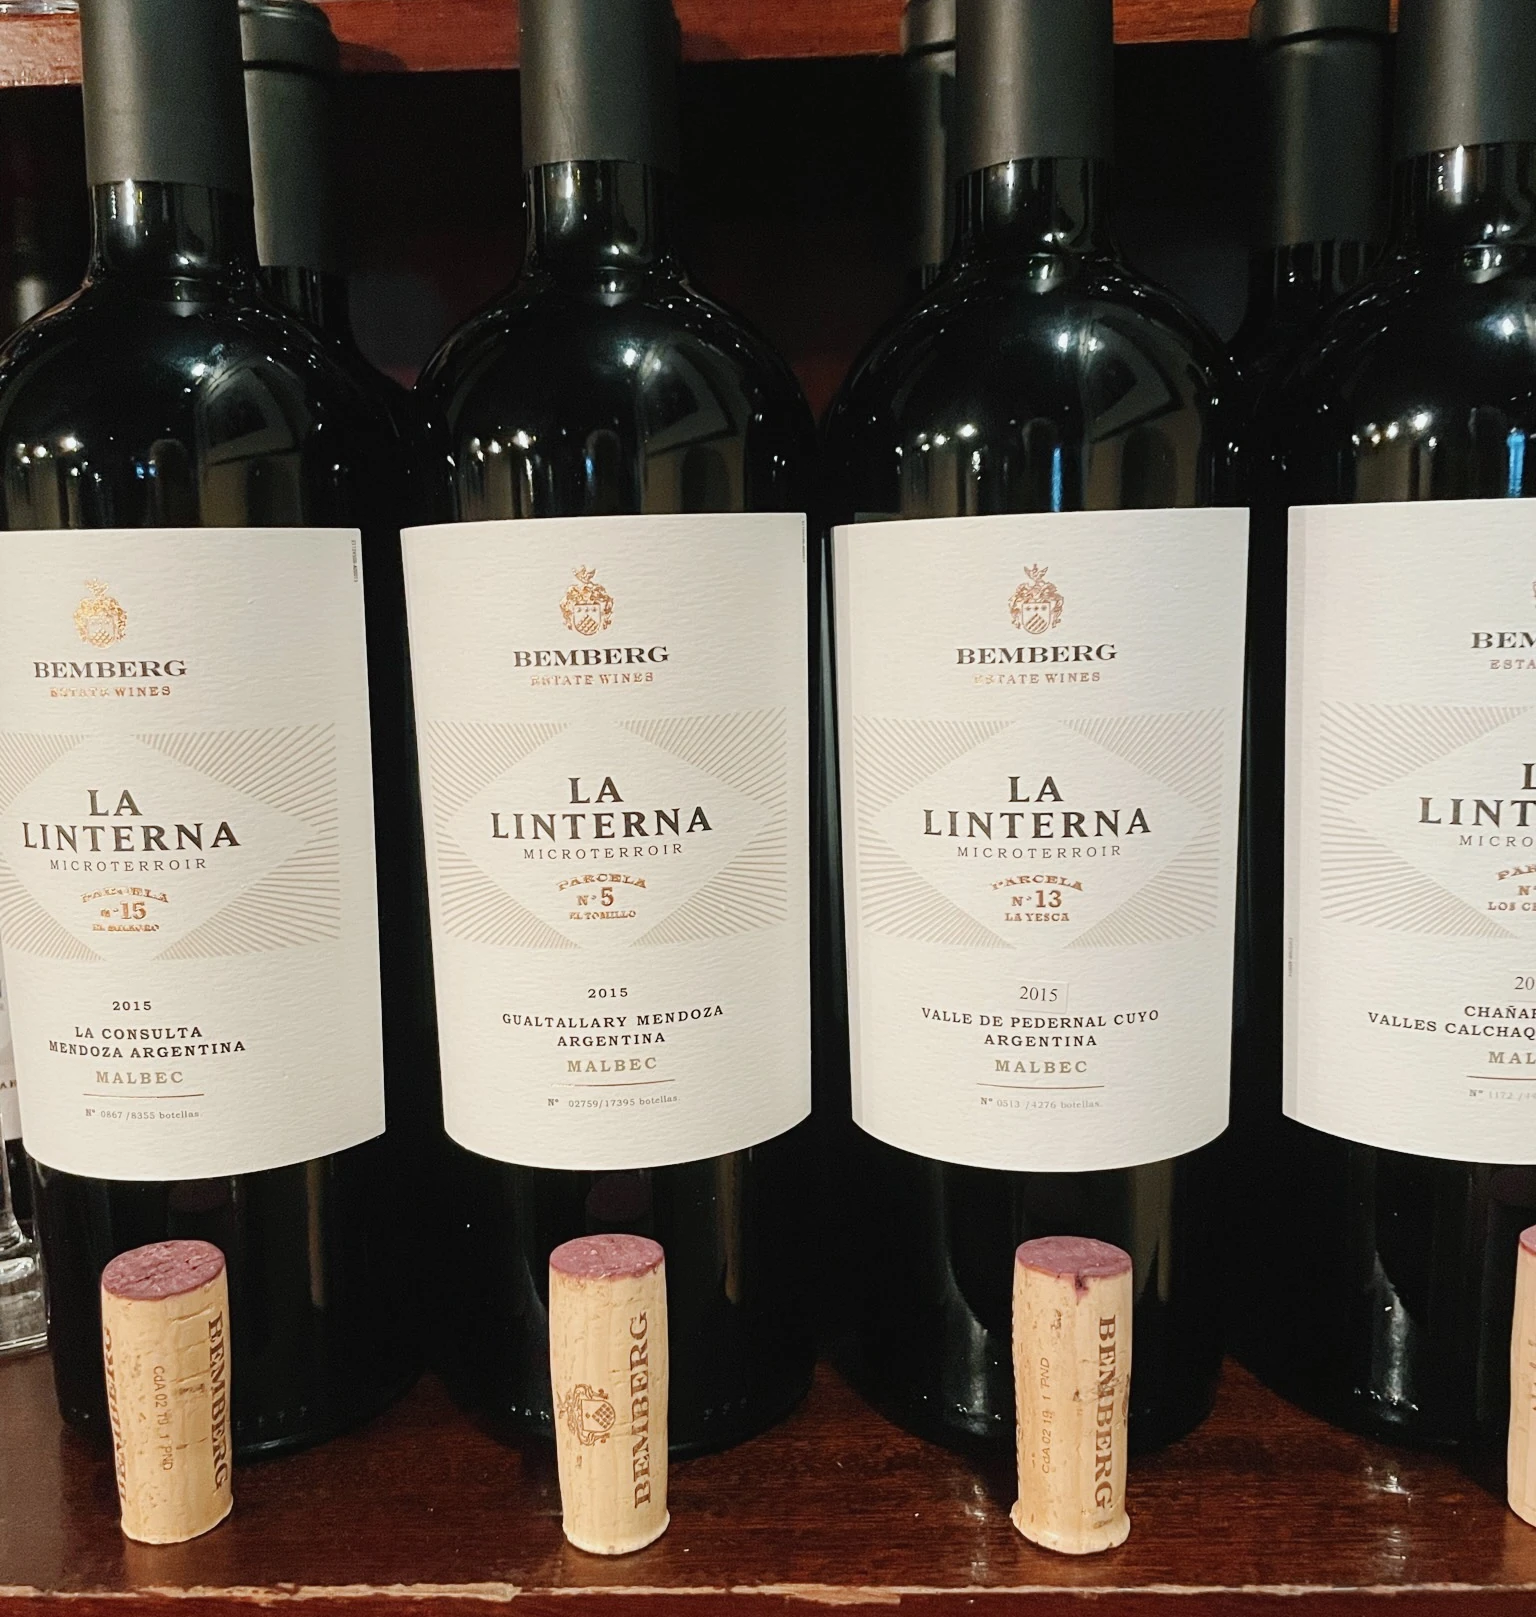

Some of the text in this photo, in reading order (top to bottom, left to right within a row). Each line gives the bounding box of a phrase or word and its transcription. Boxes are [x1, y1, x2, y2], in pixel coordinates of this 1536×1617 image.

[513, 646, 671, 667] BEMBERG
[956, 644, 1118, 665] BEMBERG
[33, 660, 188, 679] BEMBERG
[974, 672, 1101, 684] ESTATE WINES
[531, 672, 654, 686] ESTATE WINES
[114, 686, 171, 697] WINES
[568, 776, 624, 804] LA
[1008, 776, 1064, 802] LA
[87, 790, 143, 816] LA
[1418, 797, 1536, 828] LINT
[490, 806, 713, 842] LINTERNA
[923, 808, 1152, 840] LINTERNA
[22, 822, 242, 853] LINTERNA
[1458, 835, 1534, 847] MICRO
[523, 844, 683, 859] MICROTERROIR
[957, 845, 1121, 858] MICROTERROIR
[50, 858, 207, 872] MICROTERROIR
[556, 873, 647, 891] PARCELA
[990, 874, 1083, 891] PARCELA
[601, 887, 614, 907] 5
[1035, 890, 1062, 908] 13
[120, 901, 146, 920] 15
[569, 910, 636, 920] EL TOMILLO
[1004, 913, 1070, 922] LA YESCA
[1514, 976, 1536, 990] 20
[587, 987, 629, 999] 2015
[1019, 986, 1058, 1002] 2015
[112, 1001, 152, 1011] 2015
[502, 1005, 724, 1028] GUALTALLARY MENDOZA
[921, 1007, 1159, 1028] VALLE DE PEDERNAL CUYO
[1368, 1011, 1536, 1040] VALLES CALCHAQ
[75, 1026, 203, 1040] LA CONSULTA
[557, 1032, 665, 1047] ARGENTINA
[984, 1034, 1097, 1047] ARGENTINA
[49, 1040, 246, 1058] MENDOZA ARGENTINA
[567, 1057, 657, 1073] MALBEC
[995, 1060, 1088, 1073] MALBEC
[96, 1071, 184, 1084] MALBEC
[100, 1110, 123, 1119] 0867
[1040, 1357, 1050, 1388] PND
[208, 1310, 229, 1490] BEMBERG
[629, 1311, 651, 1509] BEMBERG
[1094, 1314, 1116, 1509] BEMBERG
[155, 1394, 168, 1408] 02
[162, 1445, 173, 1470] PND
[1042, 1429, 1052, 1443] 02
[1042, 1447, 1051, 1474] CdA
